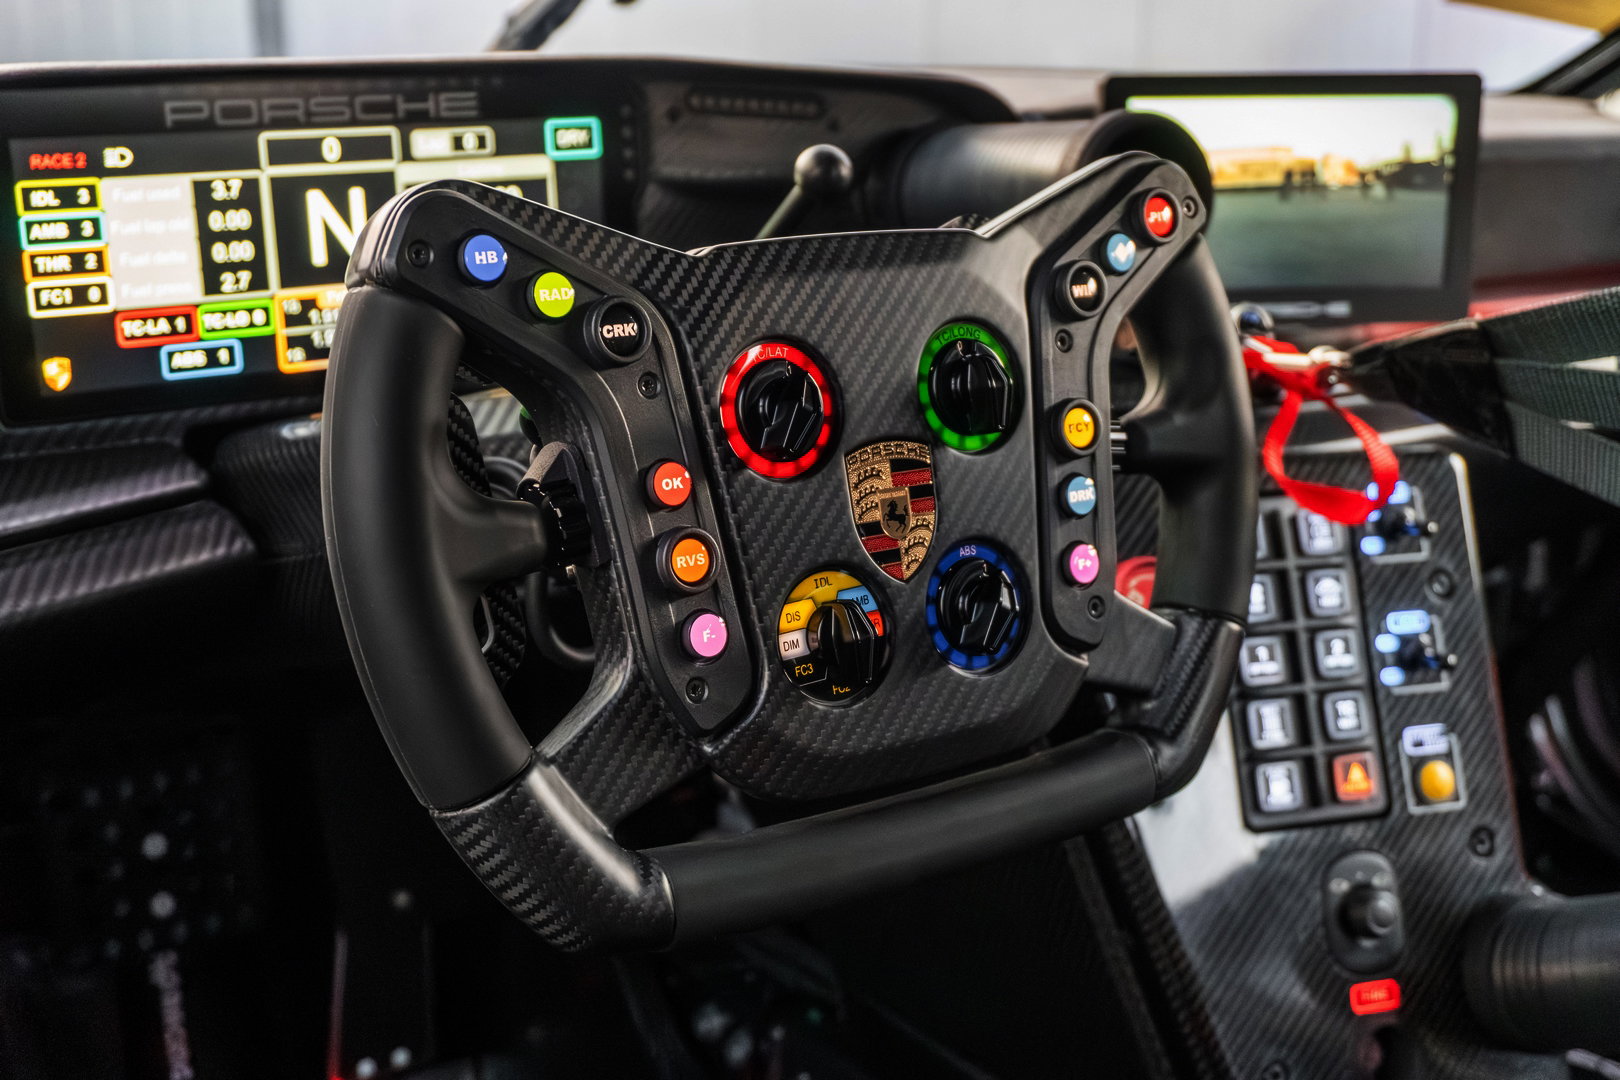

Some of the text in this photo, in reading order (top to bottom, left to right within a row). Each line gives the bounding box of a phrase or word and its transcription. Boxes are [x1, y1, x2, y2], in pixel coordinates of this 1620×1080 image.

[163, 91, 479, 128] PORSCHE
[321, 136, 342, 162] 0
[29, 152, 87, 170] RACE 2
[30, 187, 91, 207] IDL 3
[210, 178, 243, 201] 3.7
[80, 220, 94, 237] 3
[208, 208, 252, 232] 0.00
[304, 185, 367, 268] N
[211, 239, 255, 264] 0.00
[474, 251, 498, 264] HB
[33, 252, 98, 273] THR 2
[220, 270, 252, 293] 2.7
[39, 287, 73, 306] FC1
[539, 287, 573, 302] RAD
[174, 315, 187, 333] 1
[602, 323, 636, 339] CRK
[216, 347, 230, 365] 1
[1068, 422, 1090, 434] FCY
[846, 442, 930, 466] PORSCHE
[661, 477, 684, 491] OK
[1069, 487, 1093, 503] DRK
[959, 544, 977, 557] ABS
[676, 553, 705, 568] RVS
[814, 577, 833, 588] IDL
[783, 639, 800, 652] DIM
[795, 664, 814, 677] FC3
